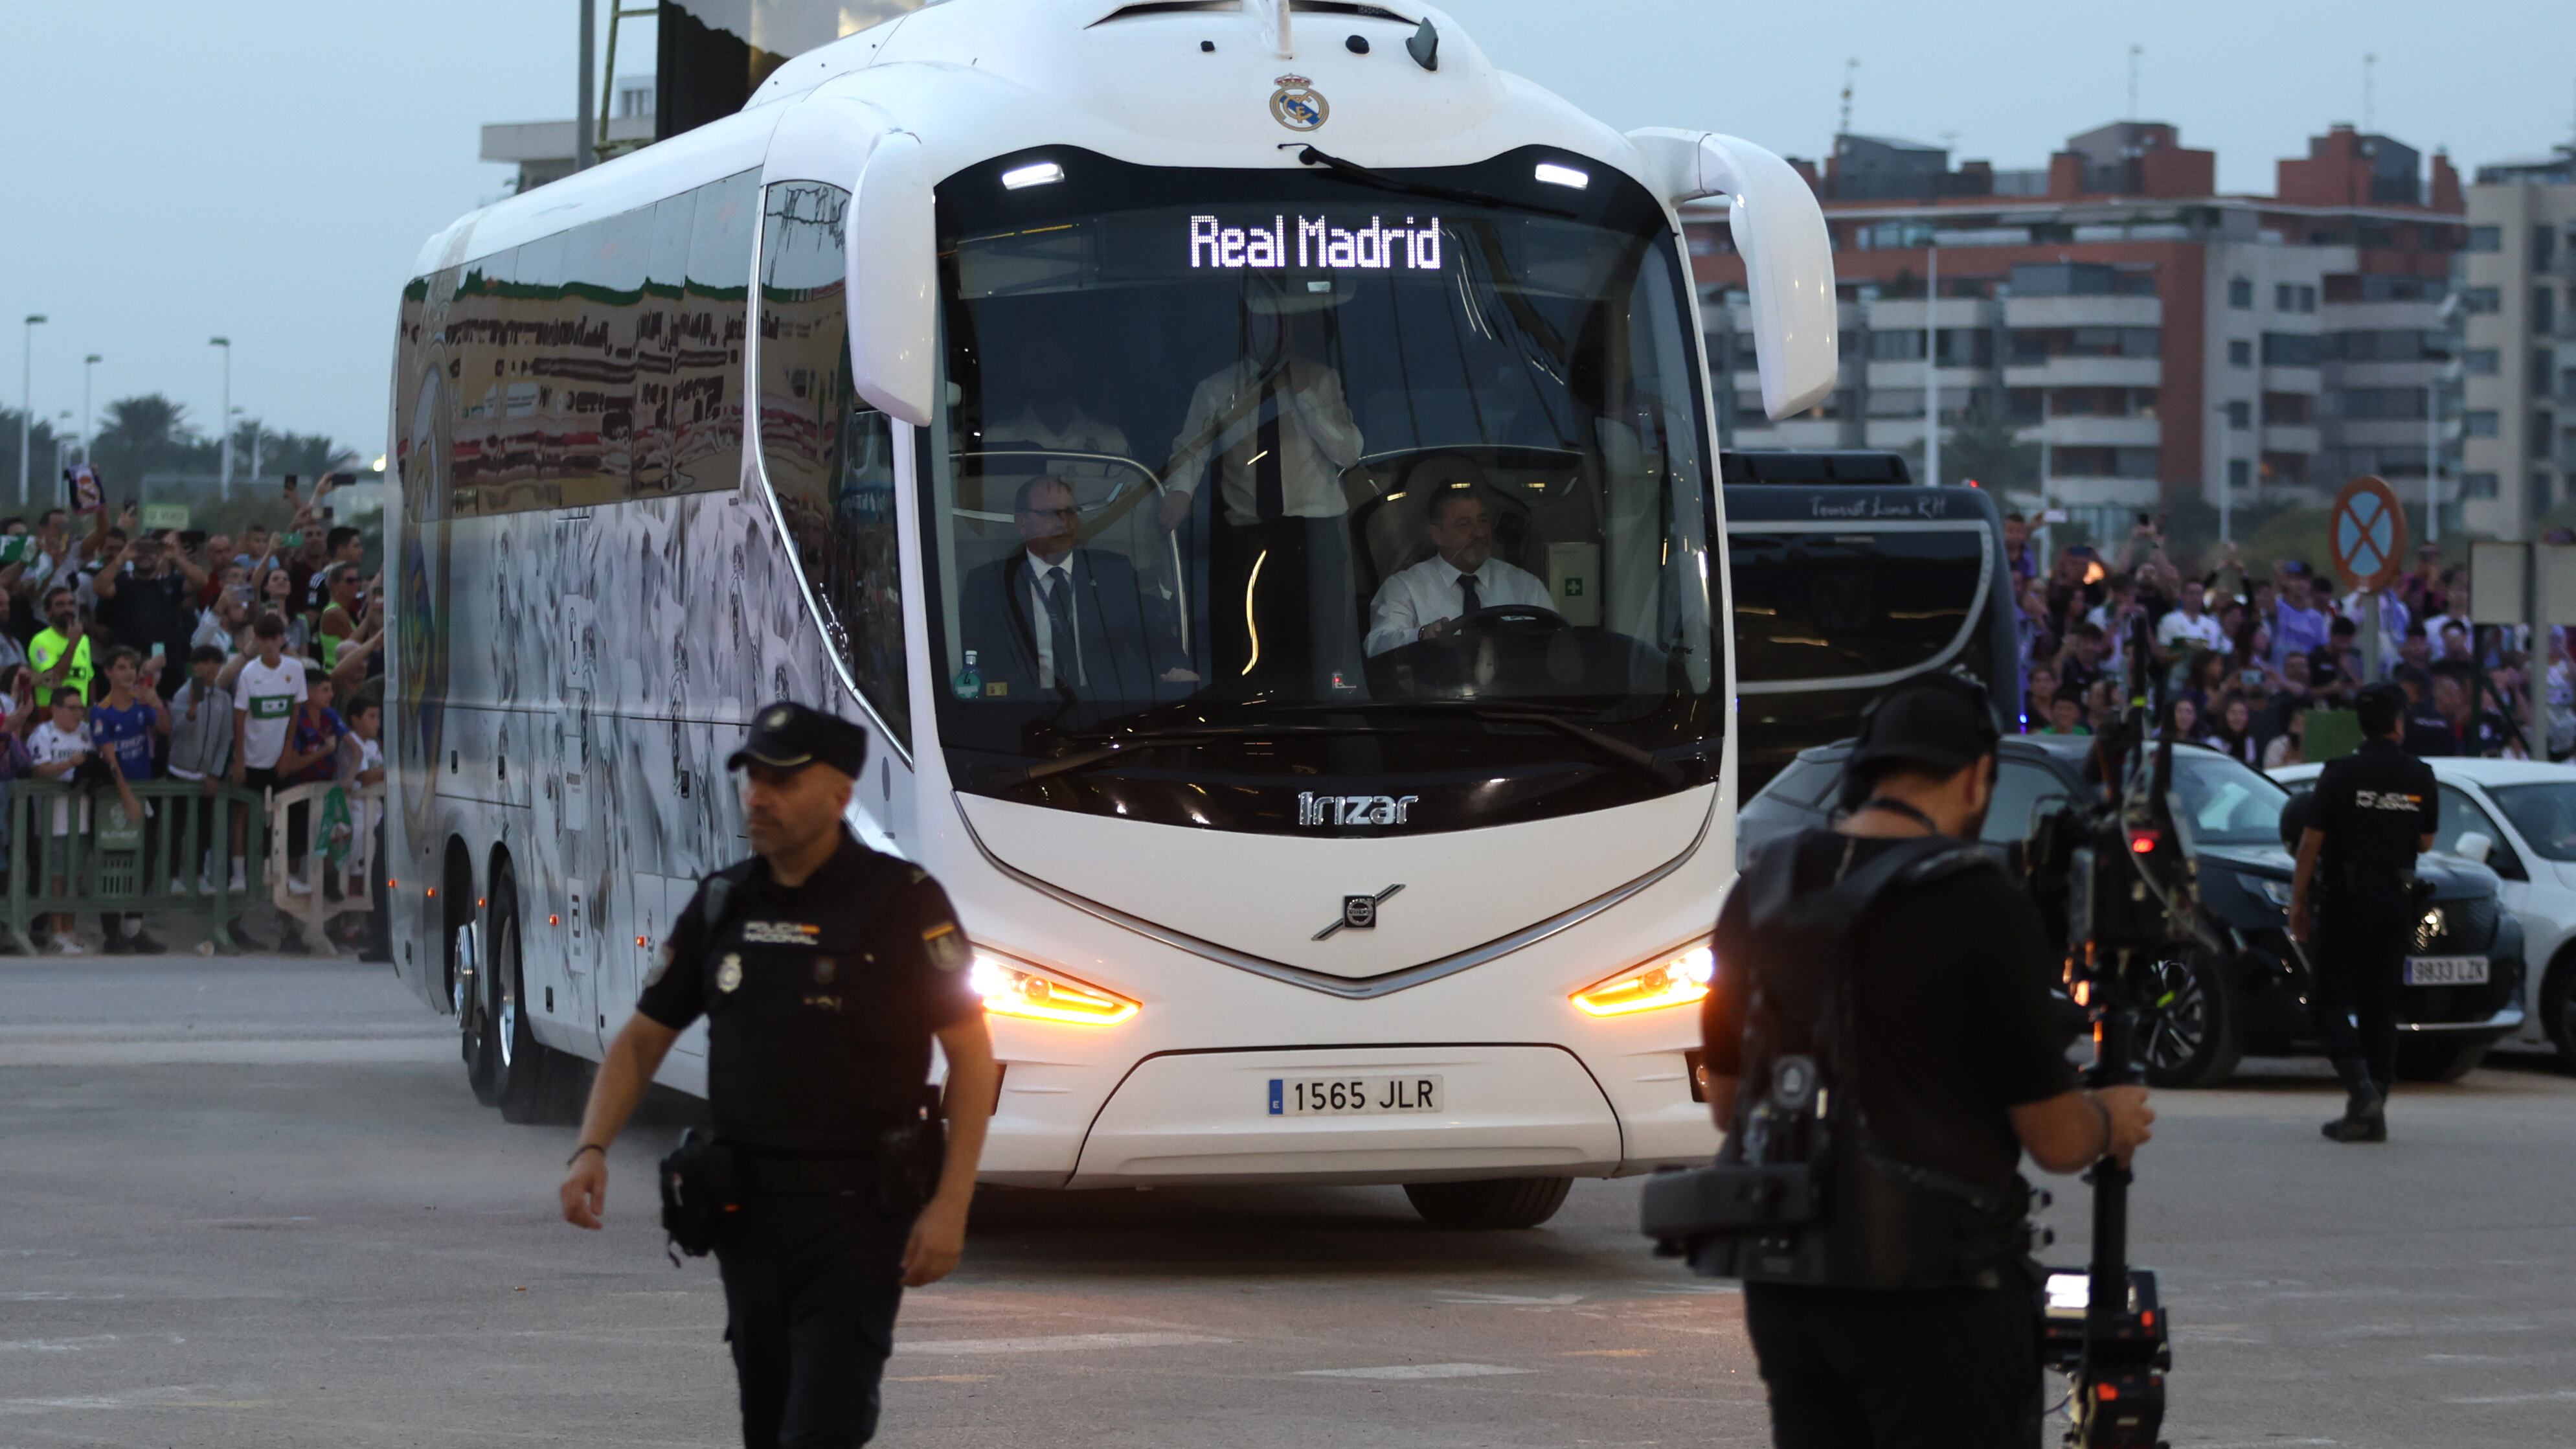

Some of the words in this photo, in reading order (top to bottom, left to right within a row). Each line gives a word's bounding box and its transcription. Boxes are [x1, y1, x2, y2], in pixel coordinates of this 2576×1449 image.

[1192, 216, 1285, 267] Real
[1298, 215, 1440, 269] Madrid
[1295, 1082, 1365, 1110] 1565
[1379, 1080, 1433, 1108] JLR
